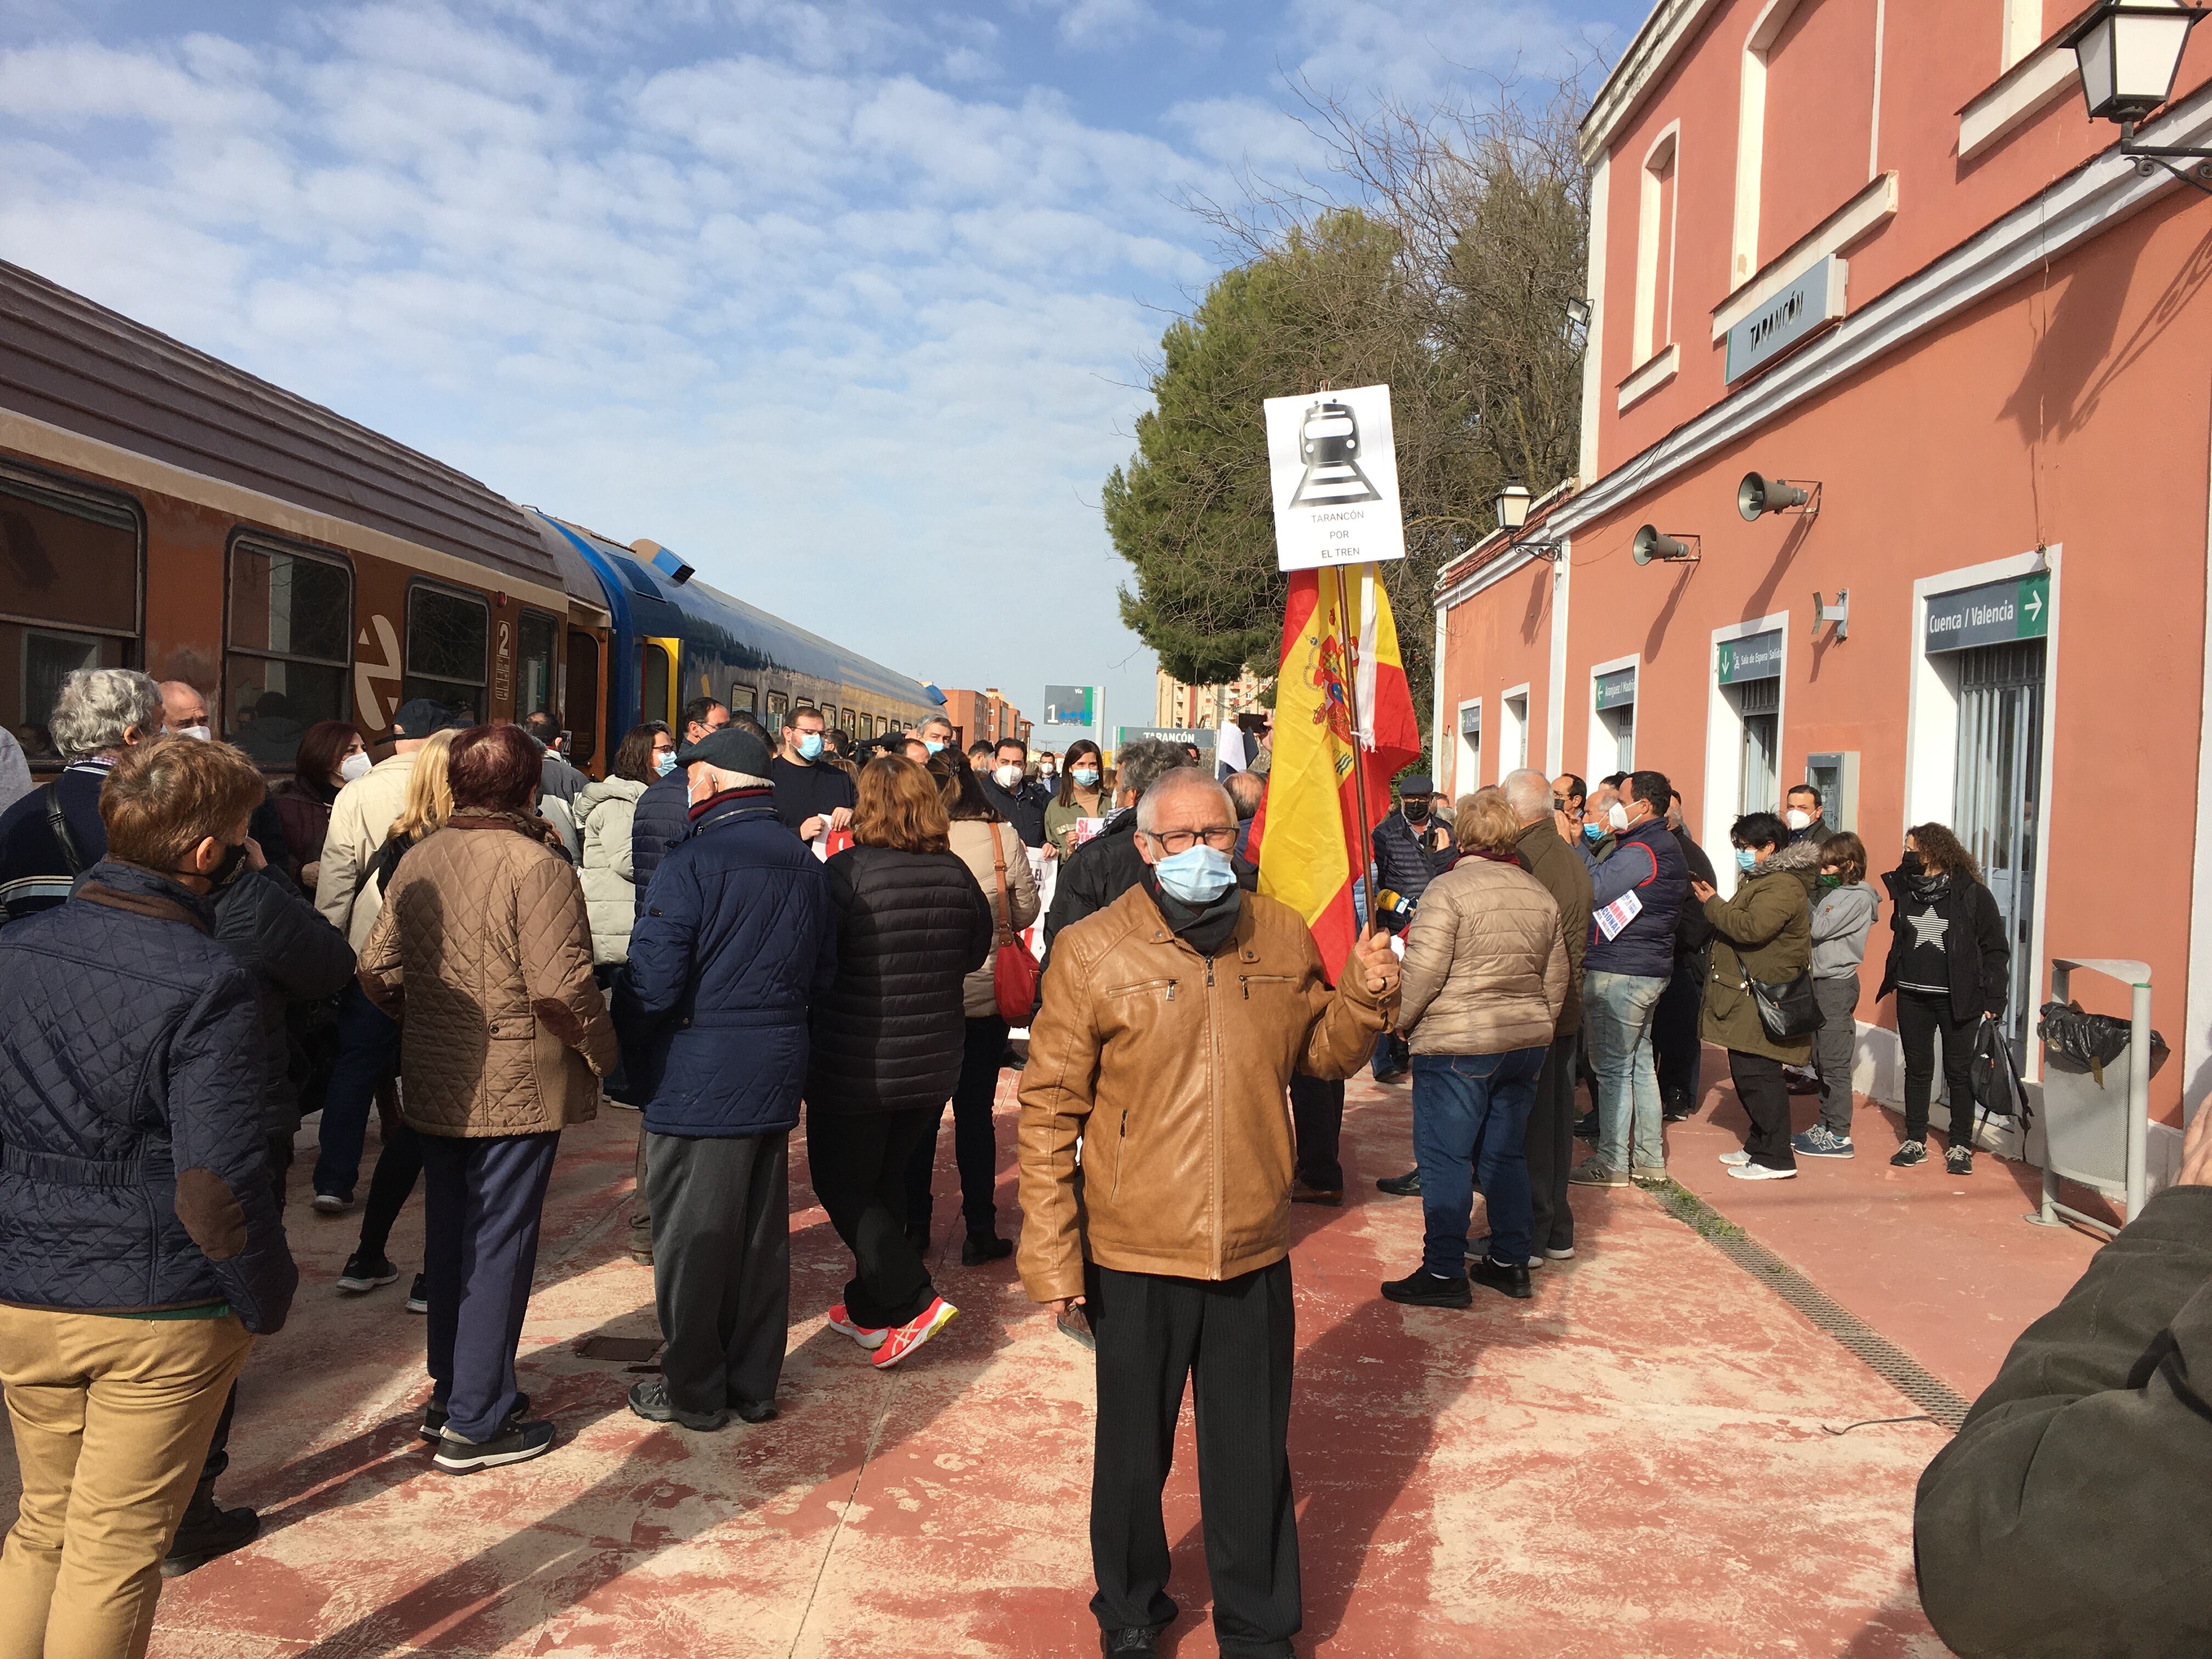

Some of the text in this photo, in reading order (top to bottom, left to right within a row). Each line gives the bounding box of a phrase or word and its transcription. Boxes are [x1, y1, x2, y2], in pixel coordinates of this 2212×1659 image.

[1751, 290, 1804, 352] TARANCÓN
[1311, 510, 1364, 523] TARANCÓN
[1330, 530, 1349, 539] POR
[1322, 547, 1359, 558] EL TREN
[1929, 599, 2014, 634] Cuenca / Valencia
[499, 623, 509, 656] 2
[1741, 654, 1749, 665] Sala
[1750, 653, 1754, 663] de
[1755, 652, 1768, 664] Espera
[1047, 704, 1059, 723] 1
[1078, 819, 1088, 833] SÍ
